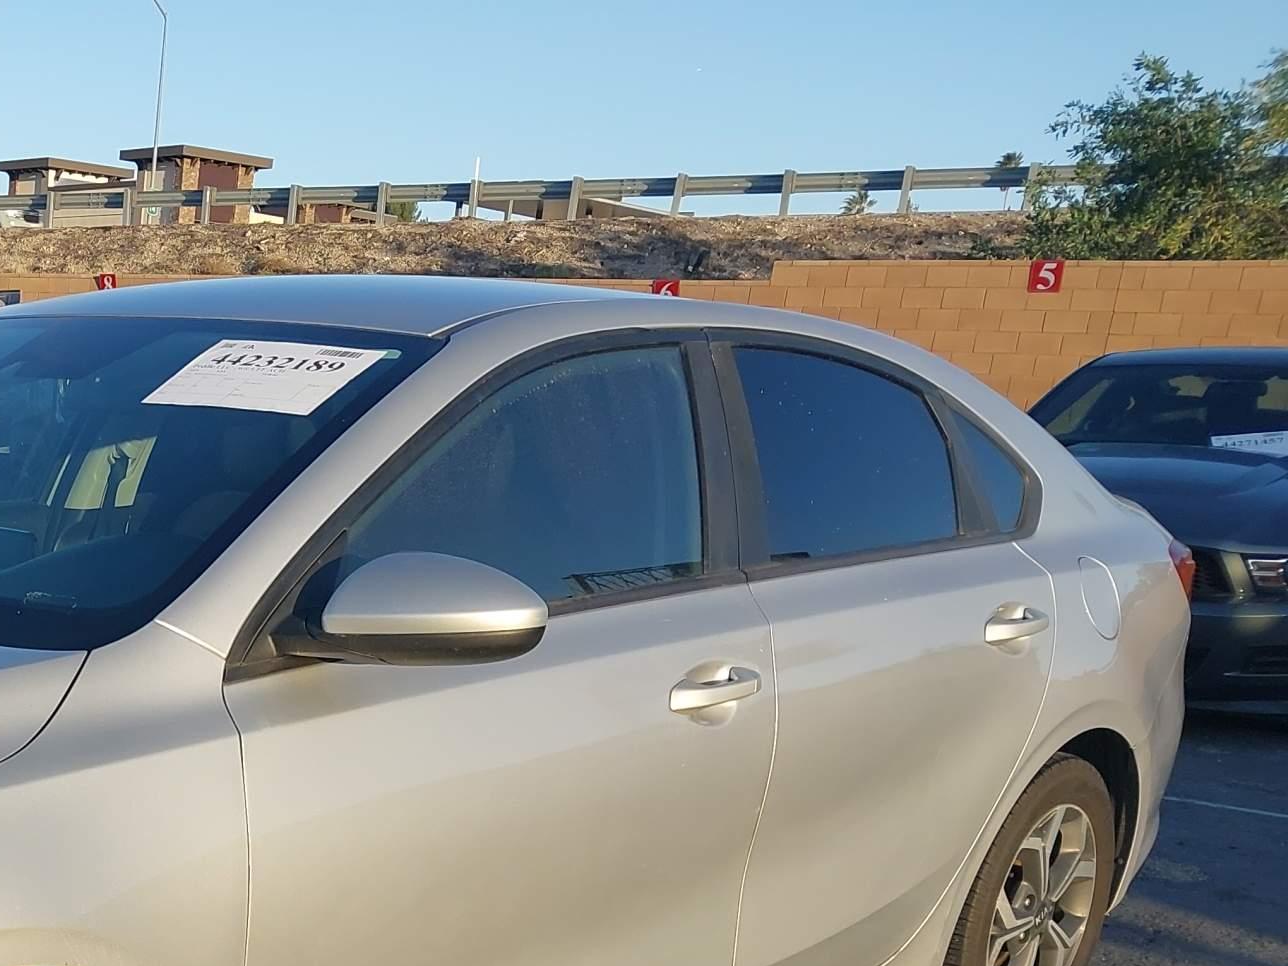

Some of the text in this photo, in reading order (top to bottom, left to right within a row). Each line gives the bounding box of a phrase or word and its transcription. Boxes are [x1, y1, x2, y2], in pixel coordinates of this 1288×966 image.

[1036, 263, 1058, 290] 5
[659, 281, 673, 297] 6
[211, 352, 346, 373] 44232189
